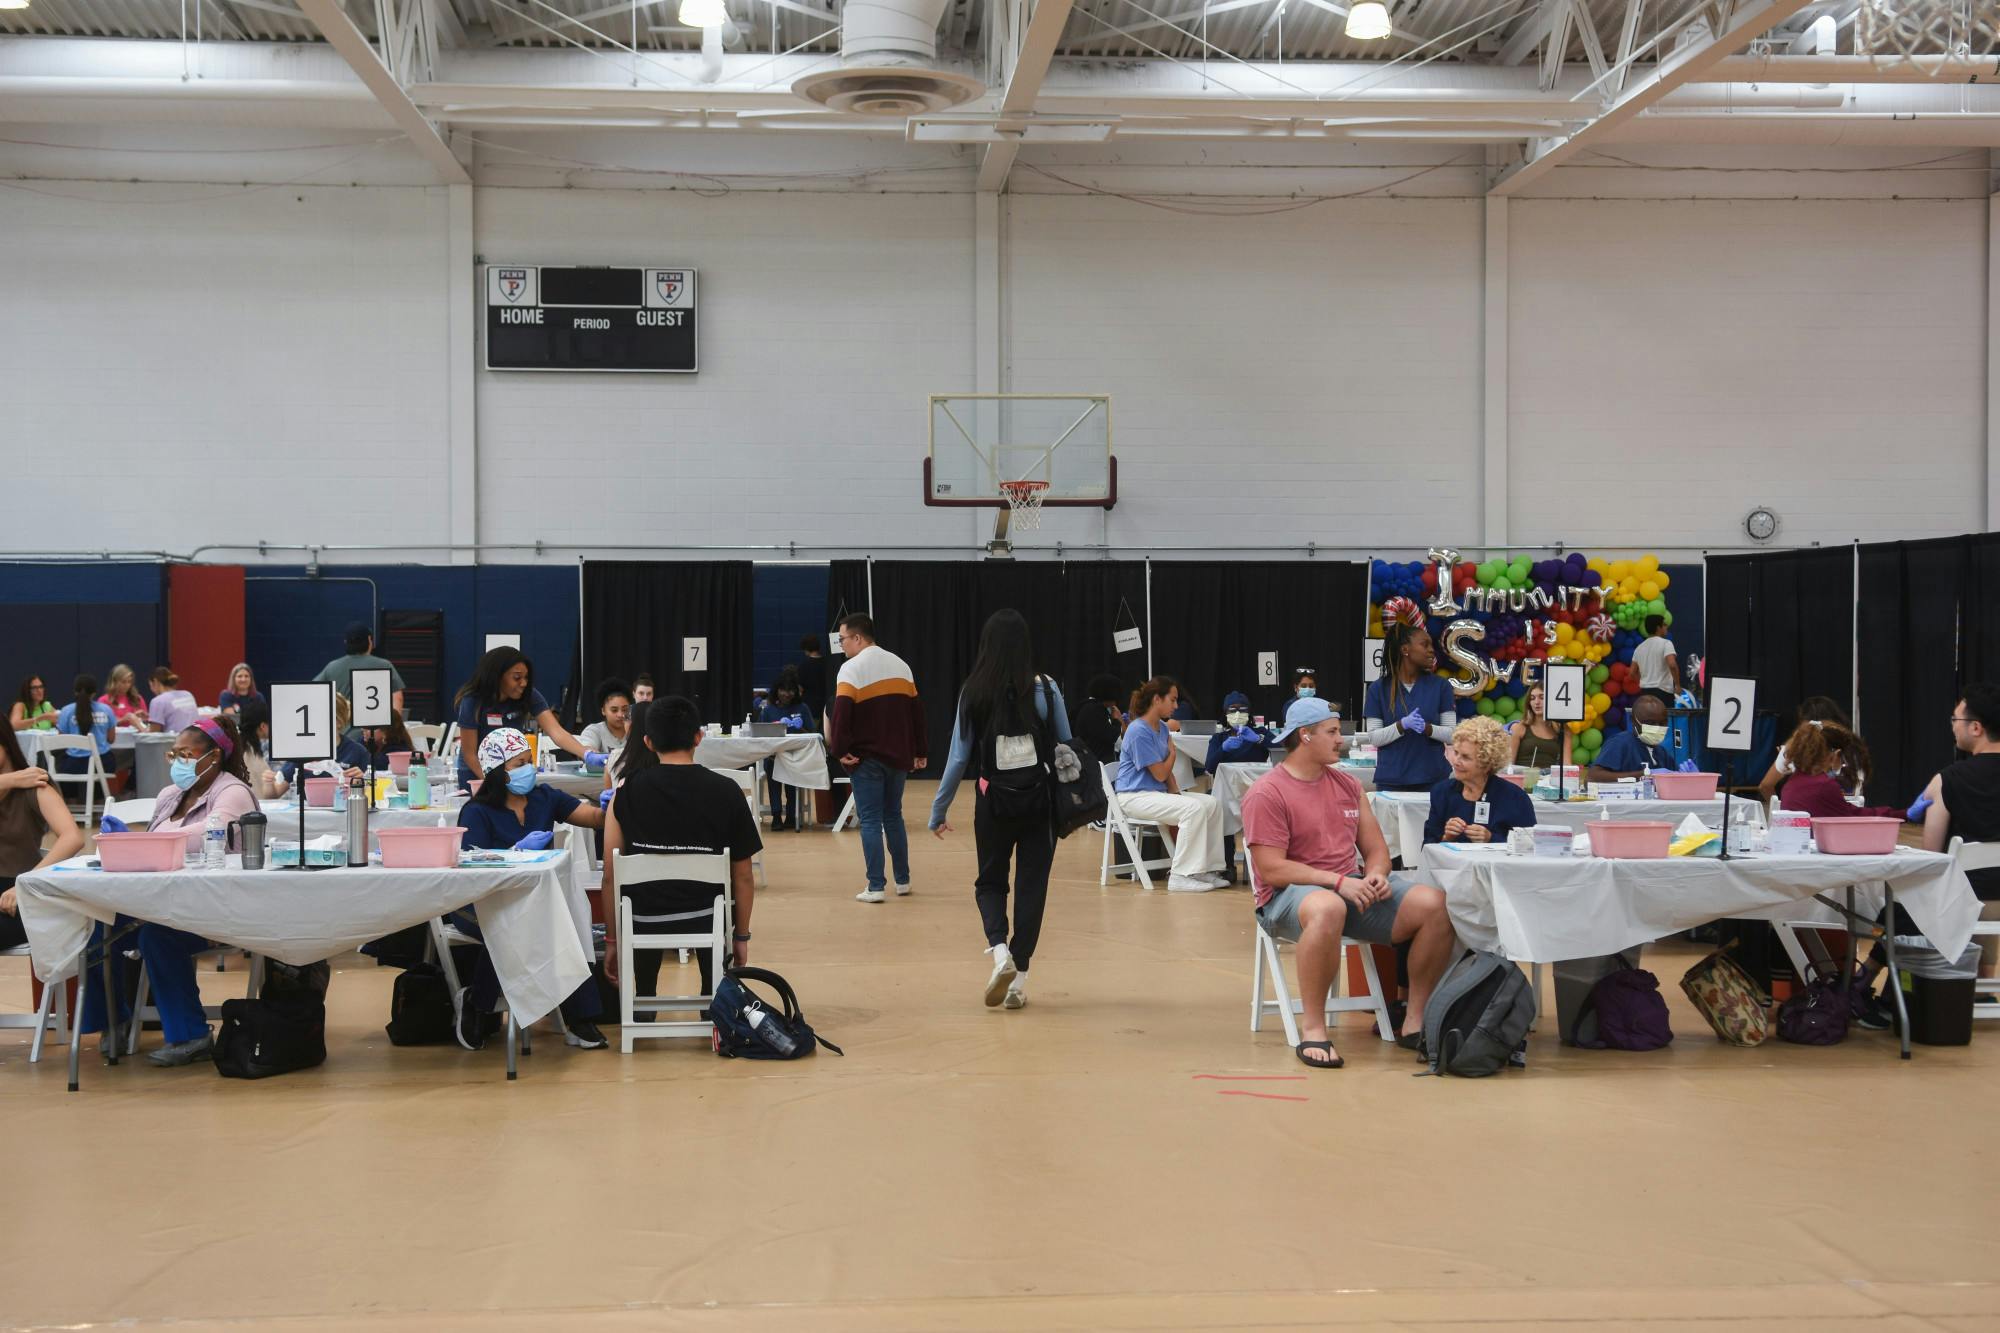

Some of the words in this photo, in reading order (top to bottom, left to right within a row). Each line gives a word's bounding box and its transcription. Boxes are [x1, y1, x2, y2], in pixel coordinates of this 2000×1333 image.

[508, 281, 519, 296] P
[665, 283, 677, 298] P
[500, 309, 544, 324] HOME
[573, 318, 610, 329] PERIOD
[636, 311, 684, 326] GUEST
[1525, 619, 1558, 645] IS
[690, 646, 700, 662] 7
[1372, 648, 1383, 668] 6
[1265, 661, 1273, 676] 8
[365, 686, 379, 710] 3
[1555, 681, 1571, 707] 4
[295, 704, 316, 737] 1
[1722, 697, 1742, 735] 2
